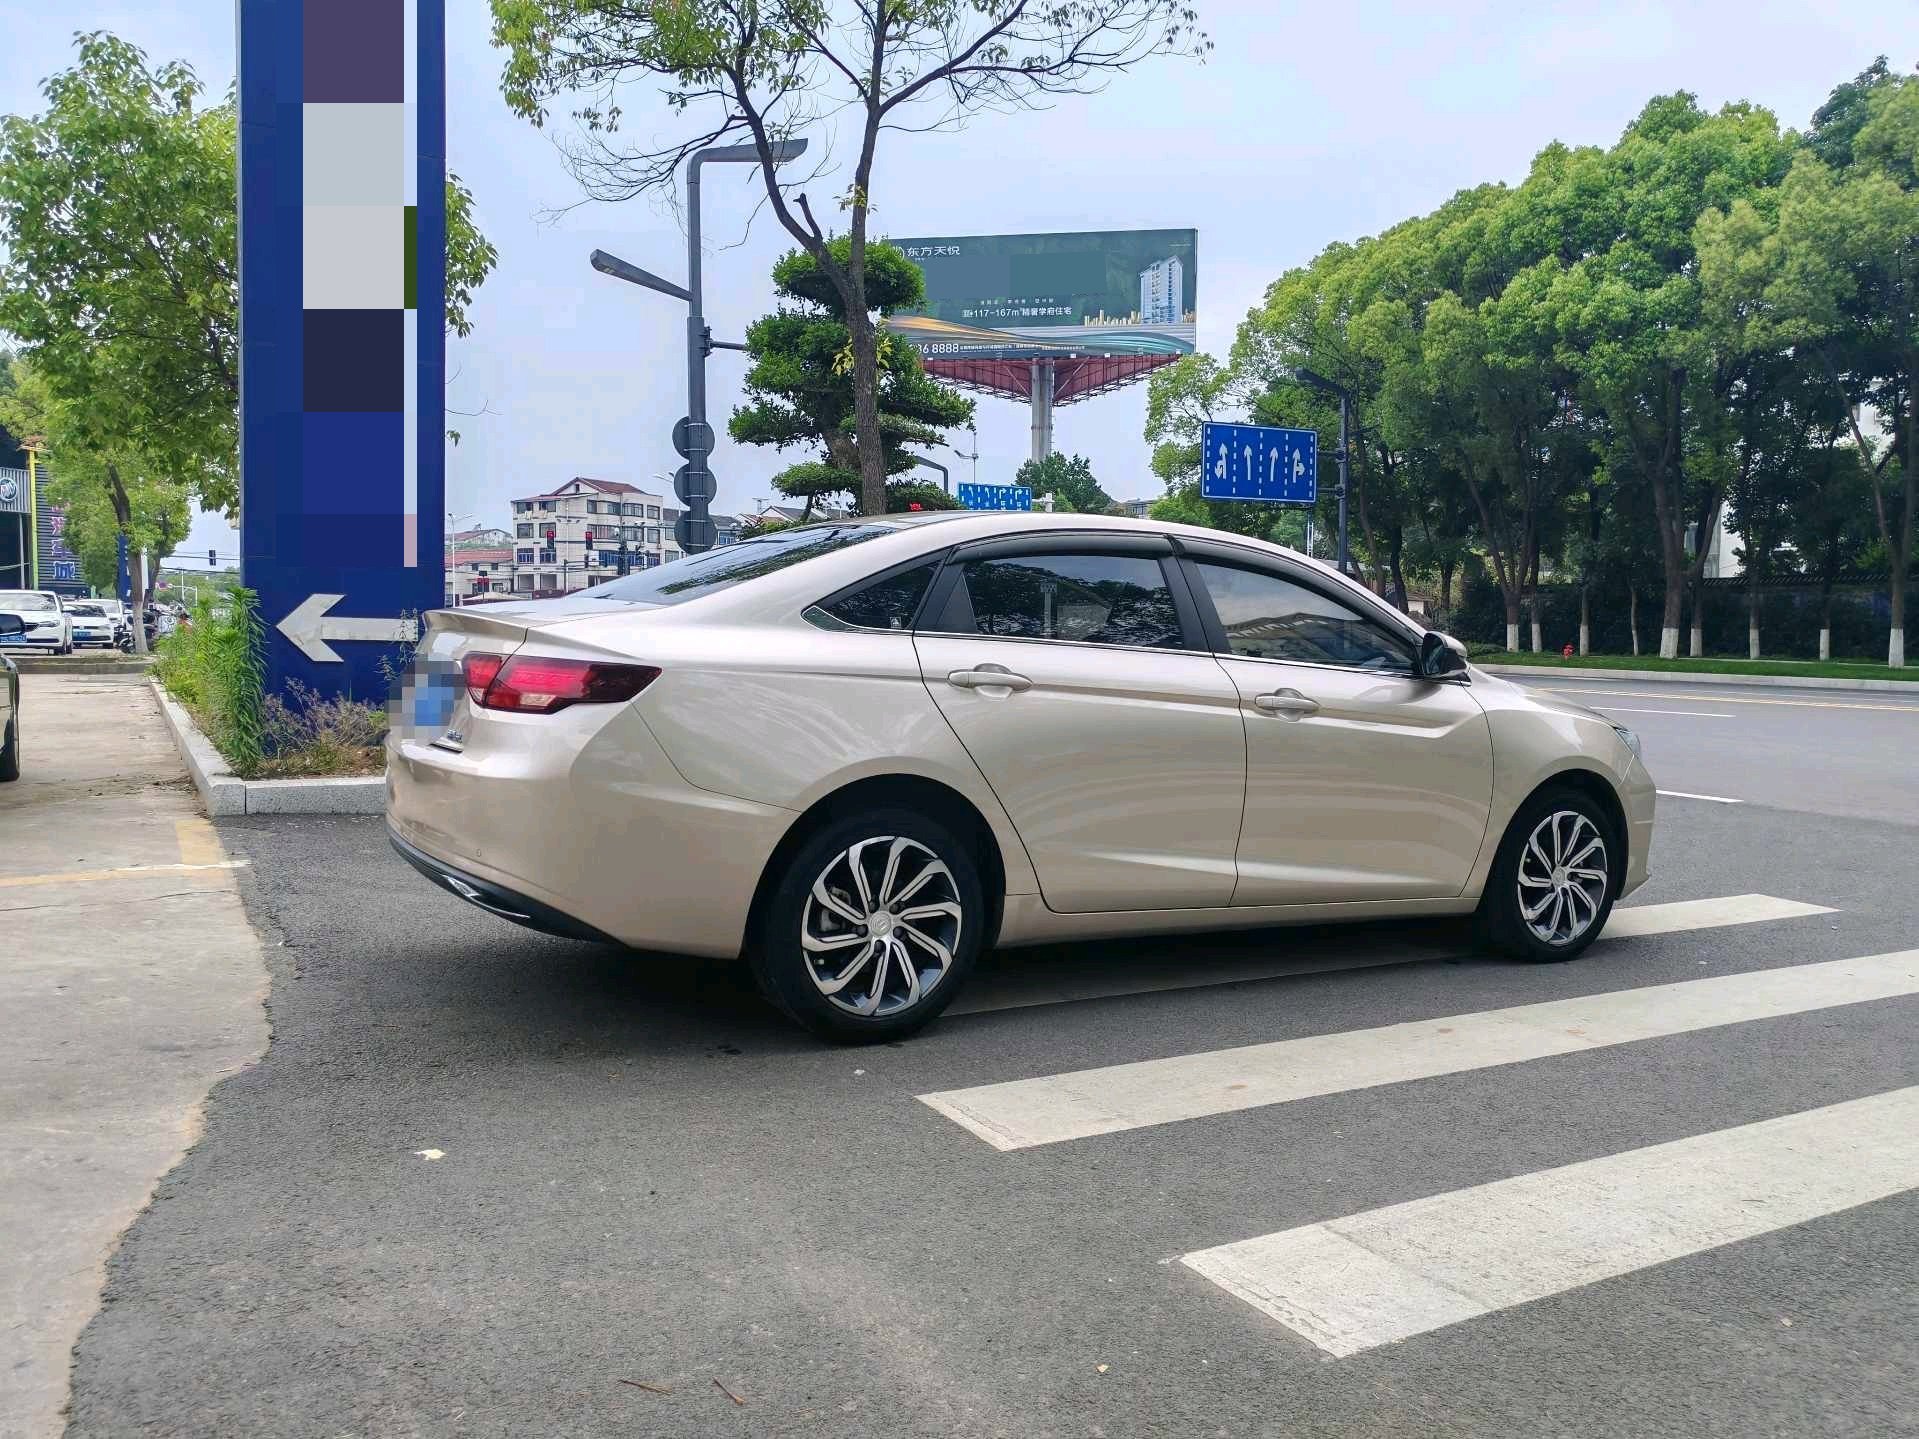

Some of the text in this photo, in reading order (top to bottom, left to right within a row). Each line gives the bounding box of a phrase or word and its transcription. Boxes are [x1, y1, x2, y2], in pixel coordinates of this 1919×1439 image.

[906, 245, 961, 257] 东方天悦
[932, 343, 959, 353] 8888
